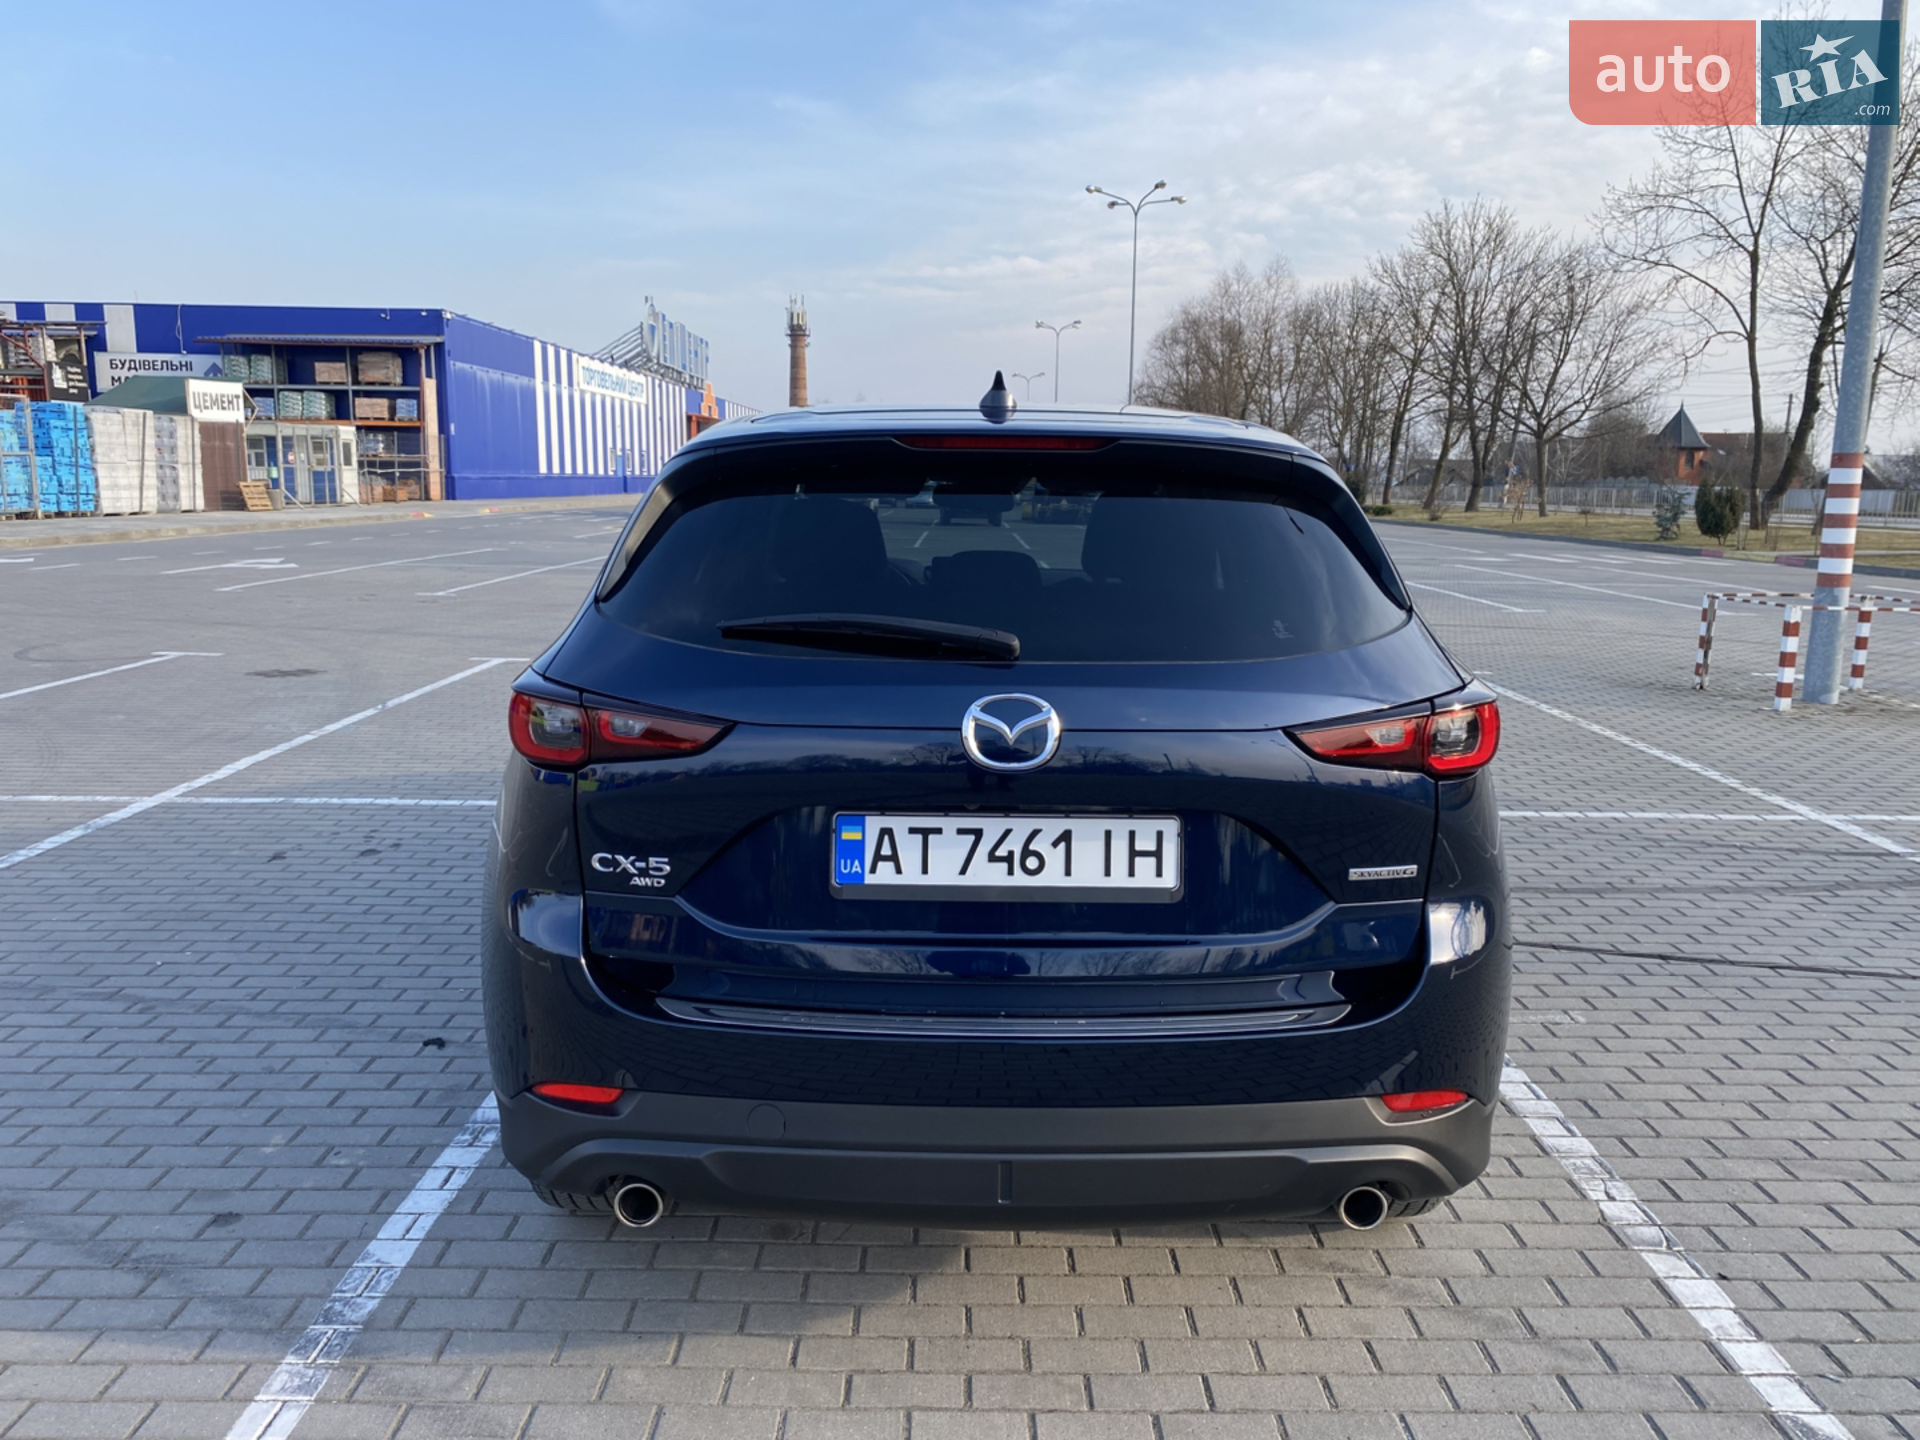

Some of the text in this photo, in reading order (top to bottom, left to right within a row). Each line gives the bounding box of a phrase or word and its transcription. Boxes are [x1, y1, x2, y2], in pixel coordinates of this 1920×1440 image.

[109, 358, 193, 372] БУДІВЕЛЬНІ
[581, 365, 644, 398] ТОРГОВЕЛЬНИЙ ЦЕНТР
[192, 391, 241, 413] ЦЕМЕНТ
[869, 827, 1164, 878] AT 7461 IH
[591, 852, 671, 876] CX-5
[840, 858, 862, 875] UA
[629, 876, 666, 888] AWD
